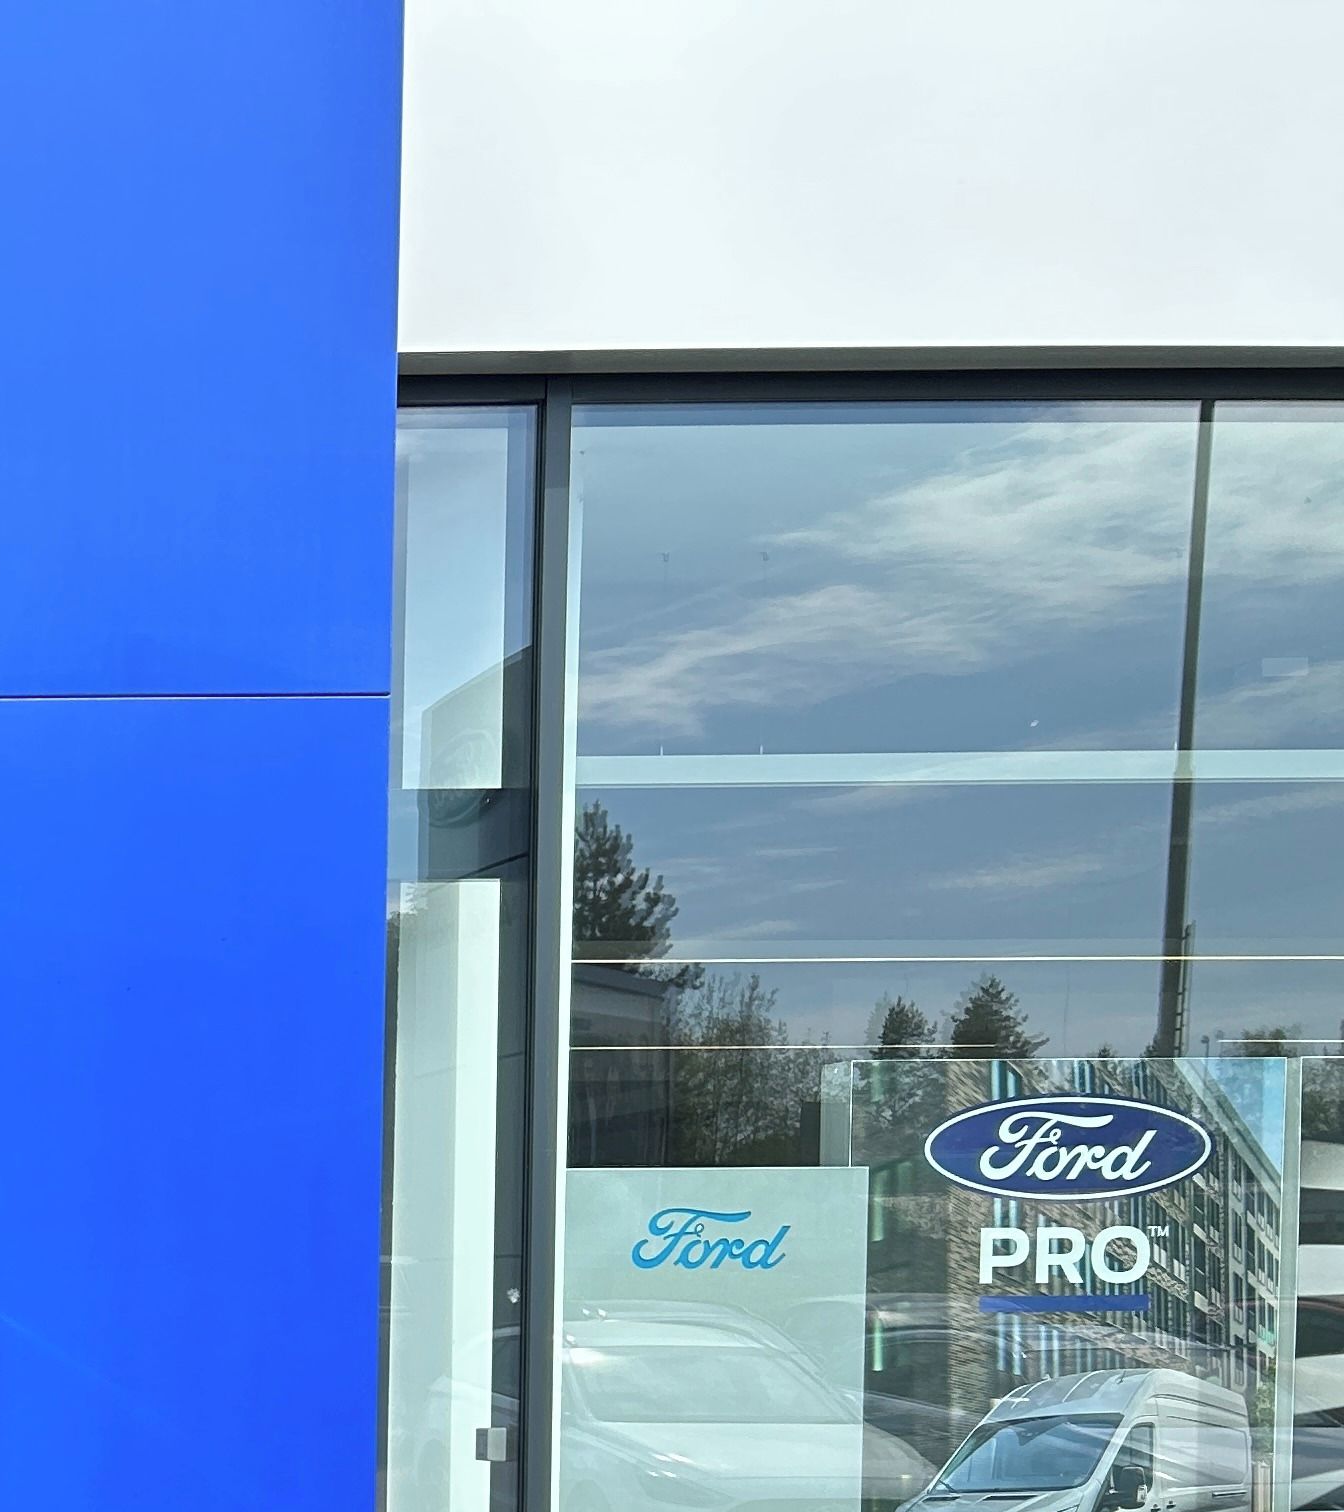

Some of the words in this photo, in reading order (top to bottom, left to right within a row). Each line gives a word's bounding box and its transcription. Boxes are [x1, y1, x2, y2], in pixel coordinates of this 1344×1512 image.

[979, 1111, 1158, 1181] Ford
[631, 1208, 792, 1269] Ford
[979, 1225, 1150, 1285] PRO
